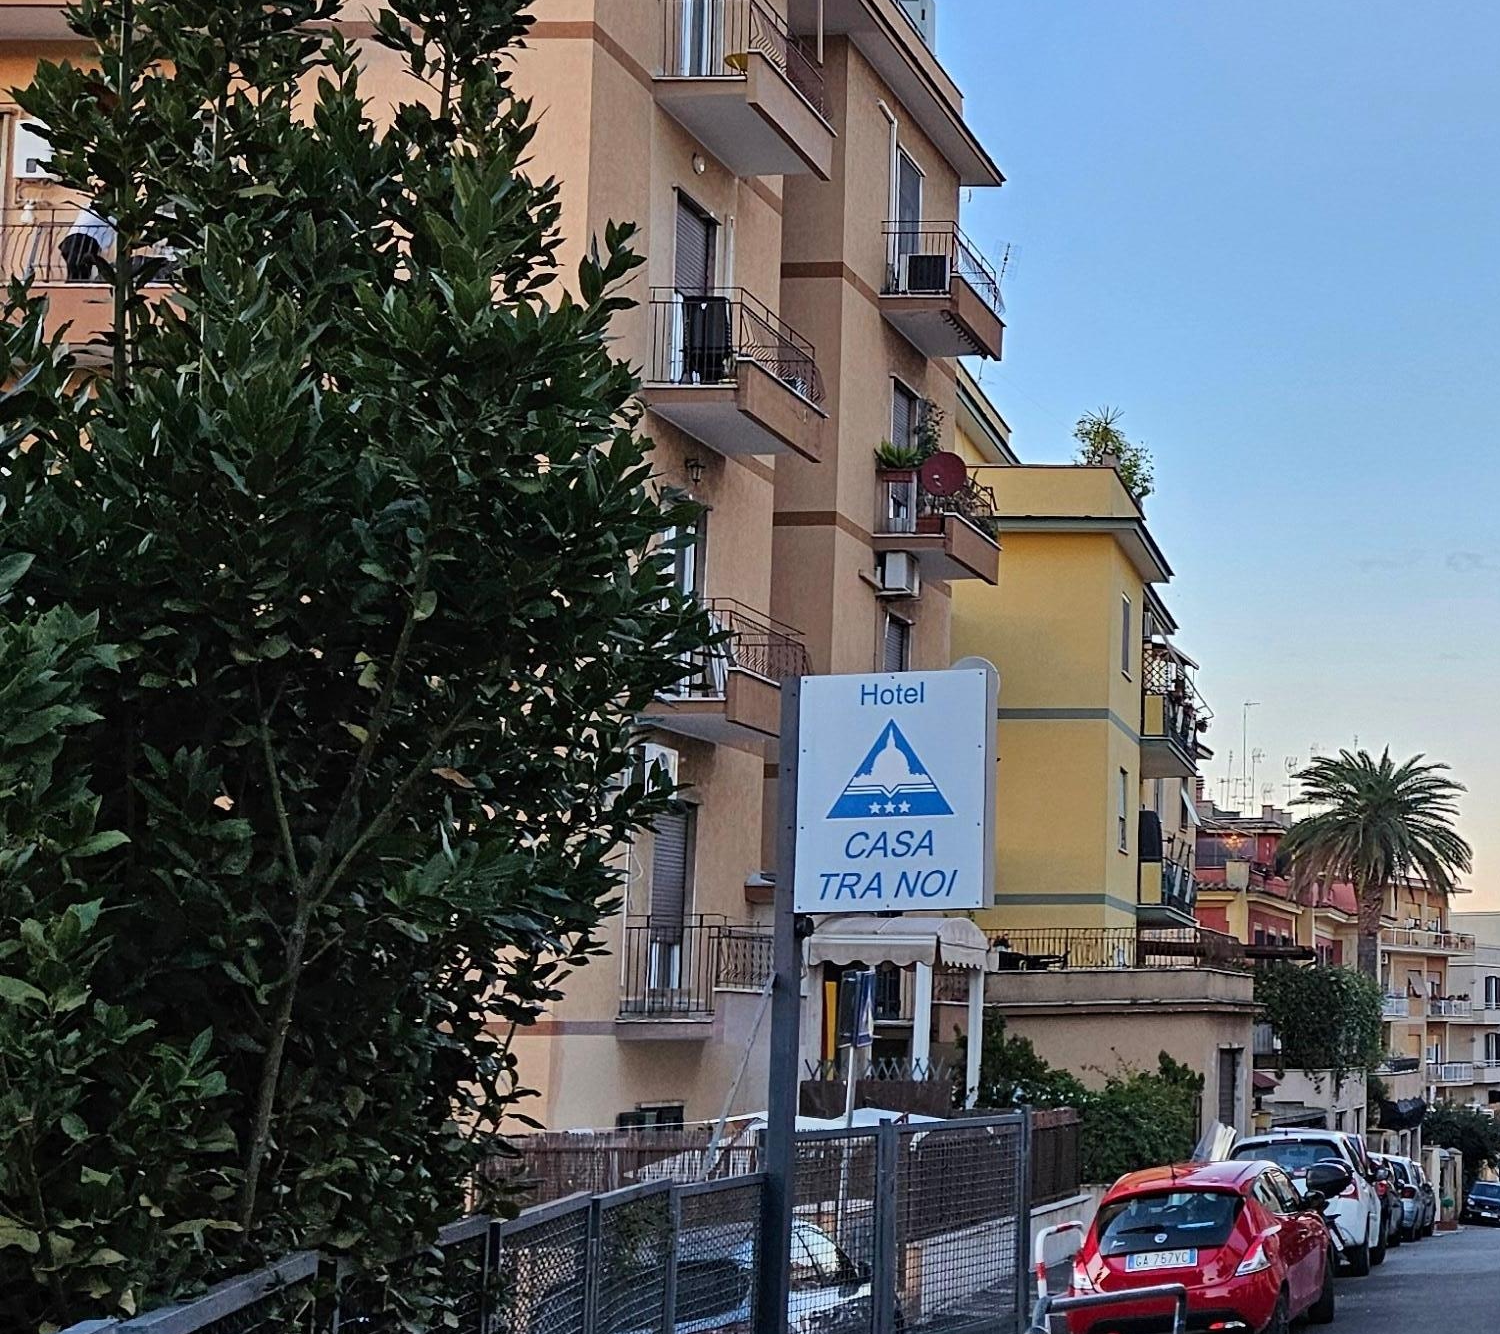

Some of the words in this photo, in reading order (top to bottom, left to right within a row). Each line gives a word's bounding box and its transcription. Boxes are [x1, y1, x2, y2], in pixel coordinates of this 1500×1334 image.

[860, 681, 925, 706] Hotel
[845, 829, 934, 859] CASA
[818, 871, 883, 901] TRA
[894, 869, 958, 899] NOI
